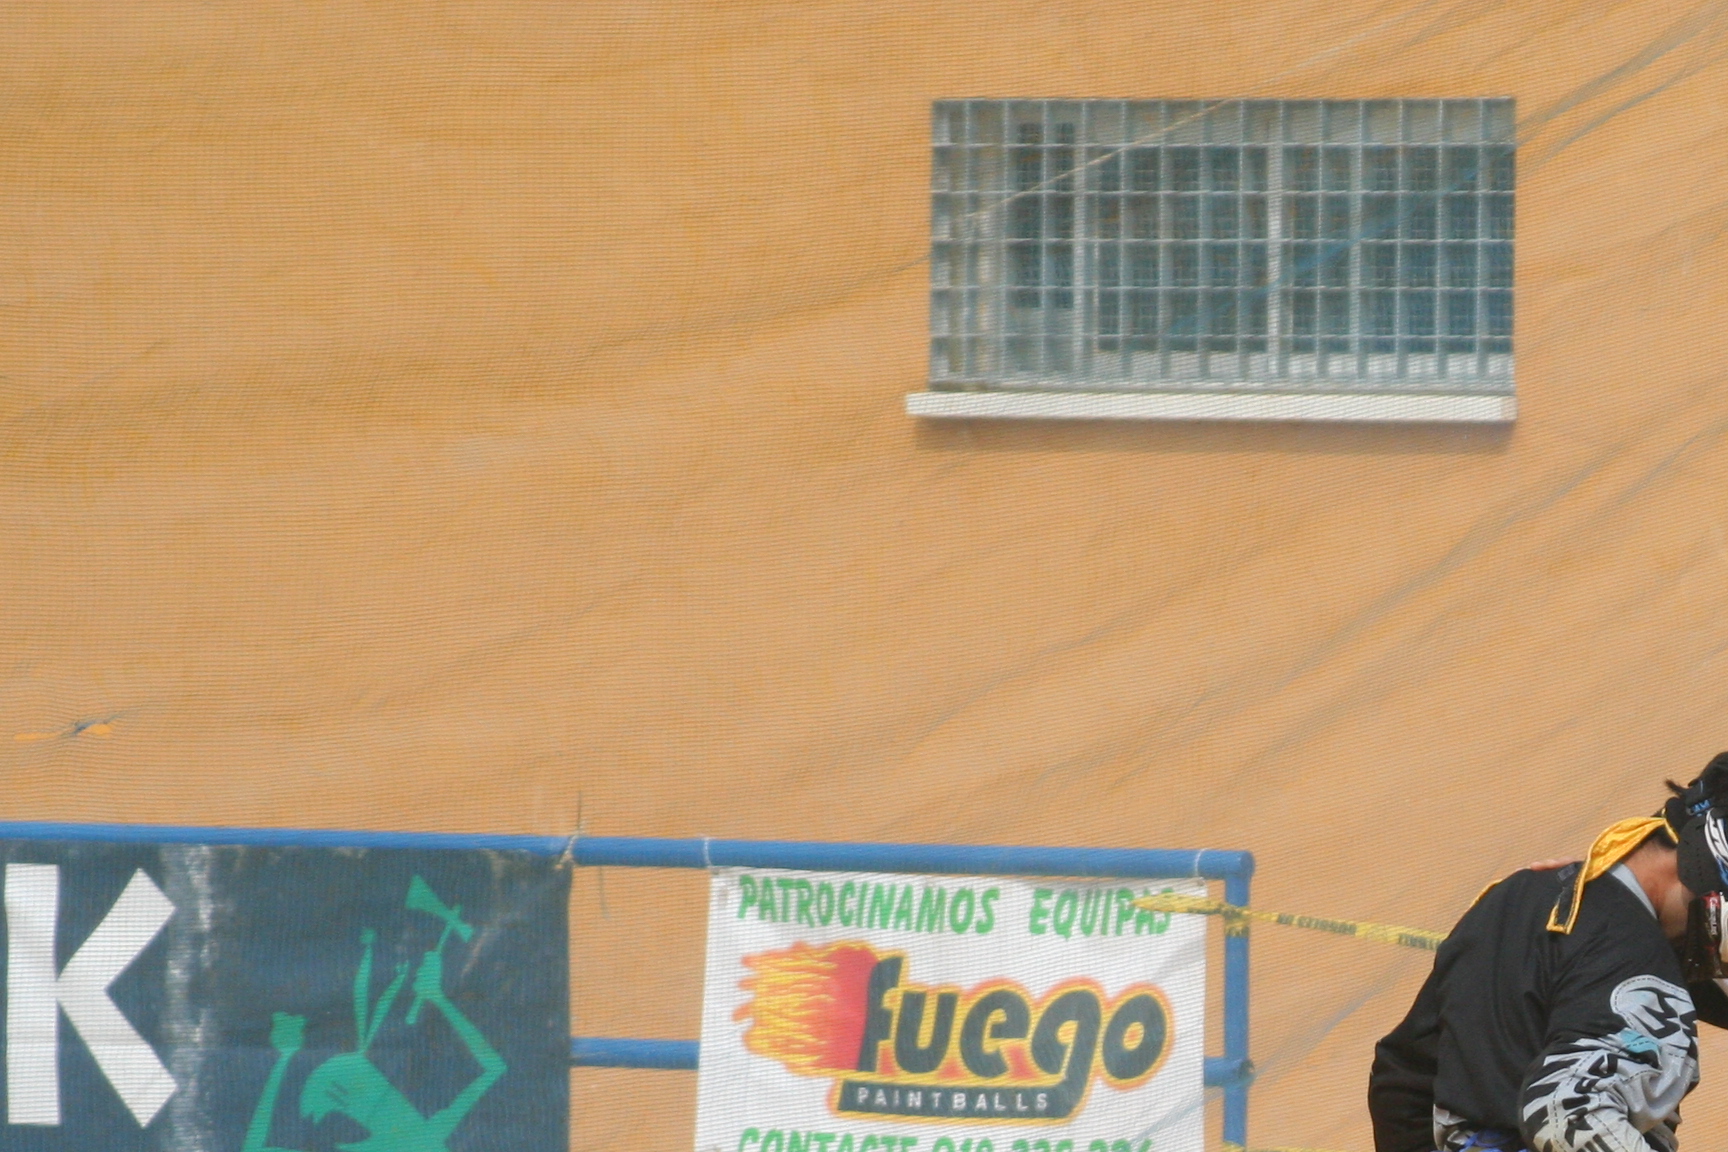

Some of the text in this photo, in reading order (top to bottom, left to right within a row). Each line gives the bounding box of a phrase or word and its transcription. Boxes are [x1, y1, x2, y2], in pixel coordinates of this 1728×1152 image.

[737, 874, 1174, 941] PATROCINAMOS EQUIPAS
[4, 862, 179, 1129] K
[857, 955, 1168, 1092] fuego
[857, 1085, 1050, 1112] PAINTBALLS
